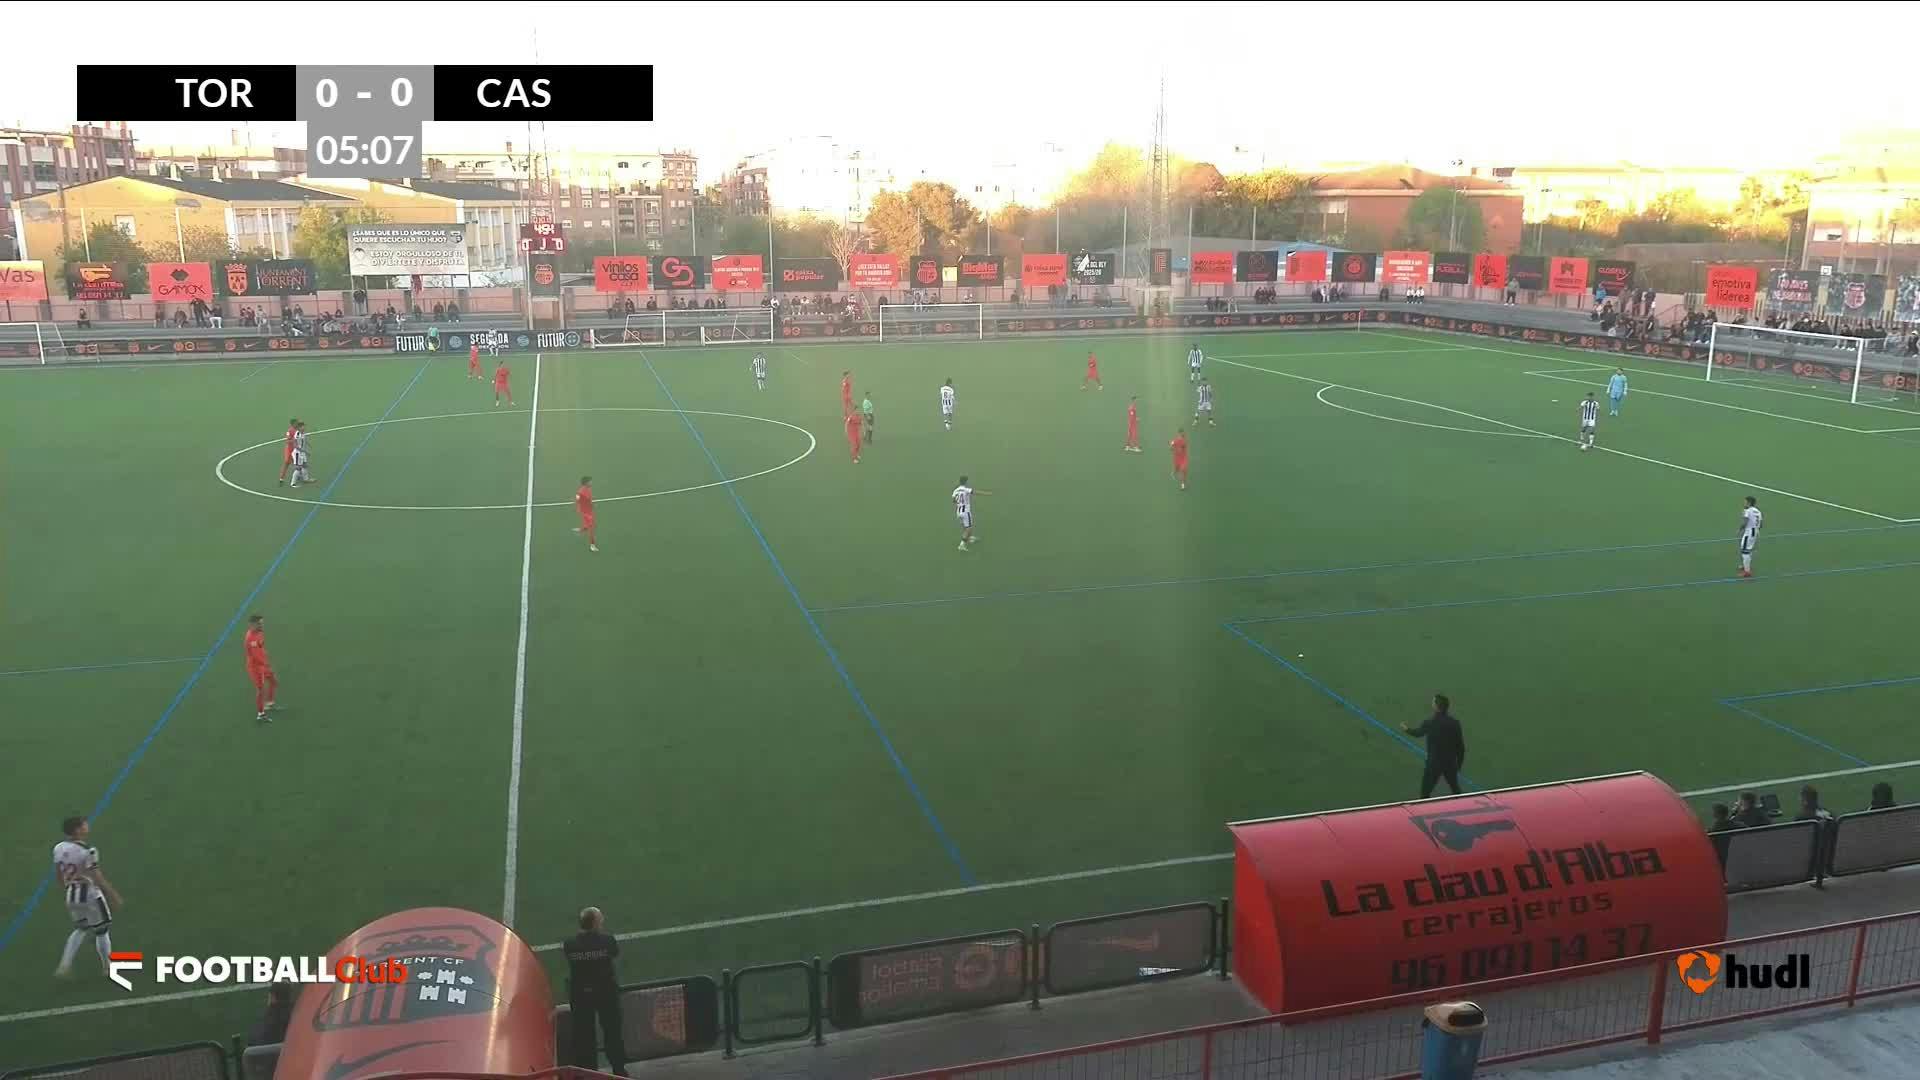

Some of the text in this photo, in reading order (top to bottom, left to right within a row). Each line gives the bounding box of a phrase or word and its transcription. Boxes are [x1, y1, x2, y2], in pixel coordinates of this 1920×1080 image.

[602, 261, 639, 272] vinilos
[609, 272, 639, 281] casa
[1712, 278, 1751, 290] emotiva
[470, 333, 509, 345] SEGUDA
[537, 333, 565, 348] FUTUR
[1320, 840, 1667, 918] La clau d'Alba
[1401, 889, 1613, 941] cerrajeros
[443, 957, 464, 965] CF
[1391, 923, 1654, 990] 96 091 14 37
